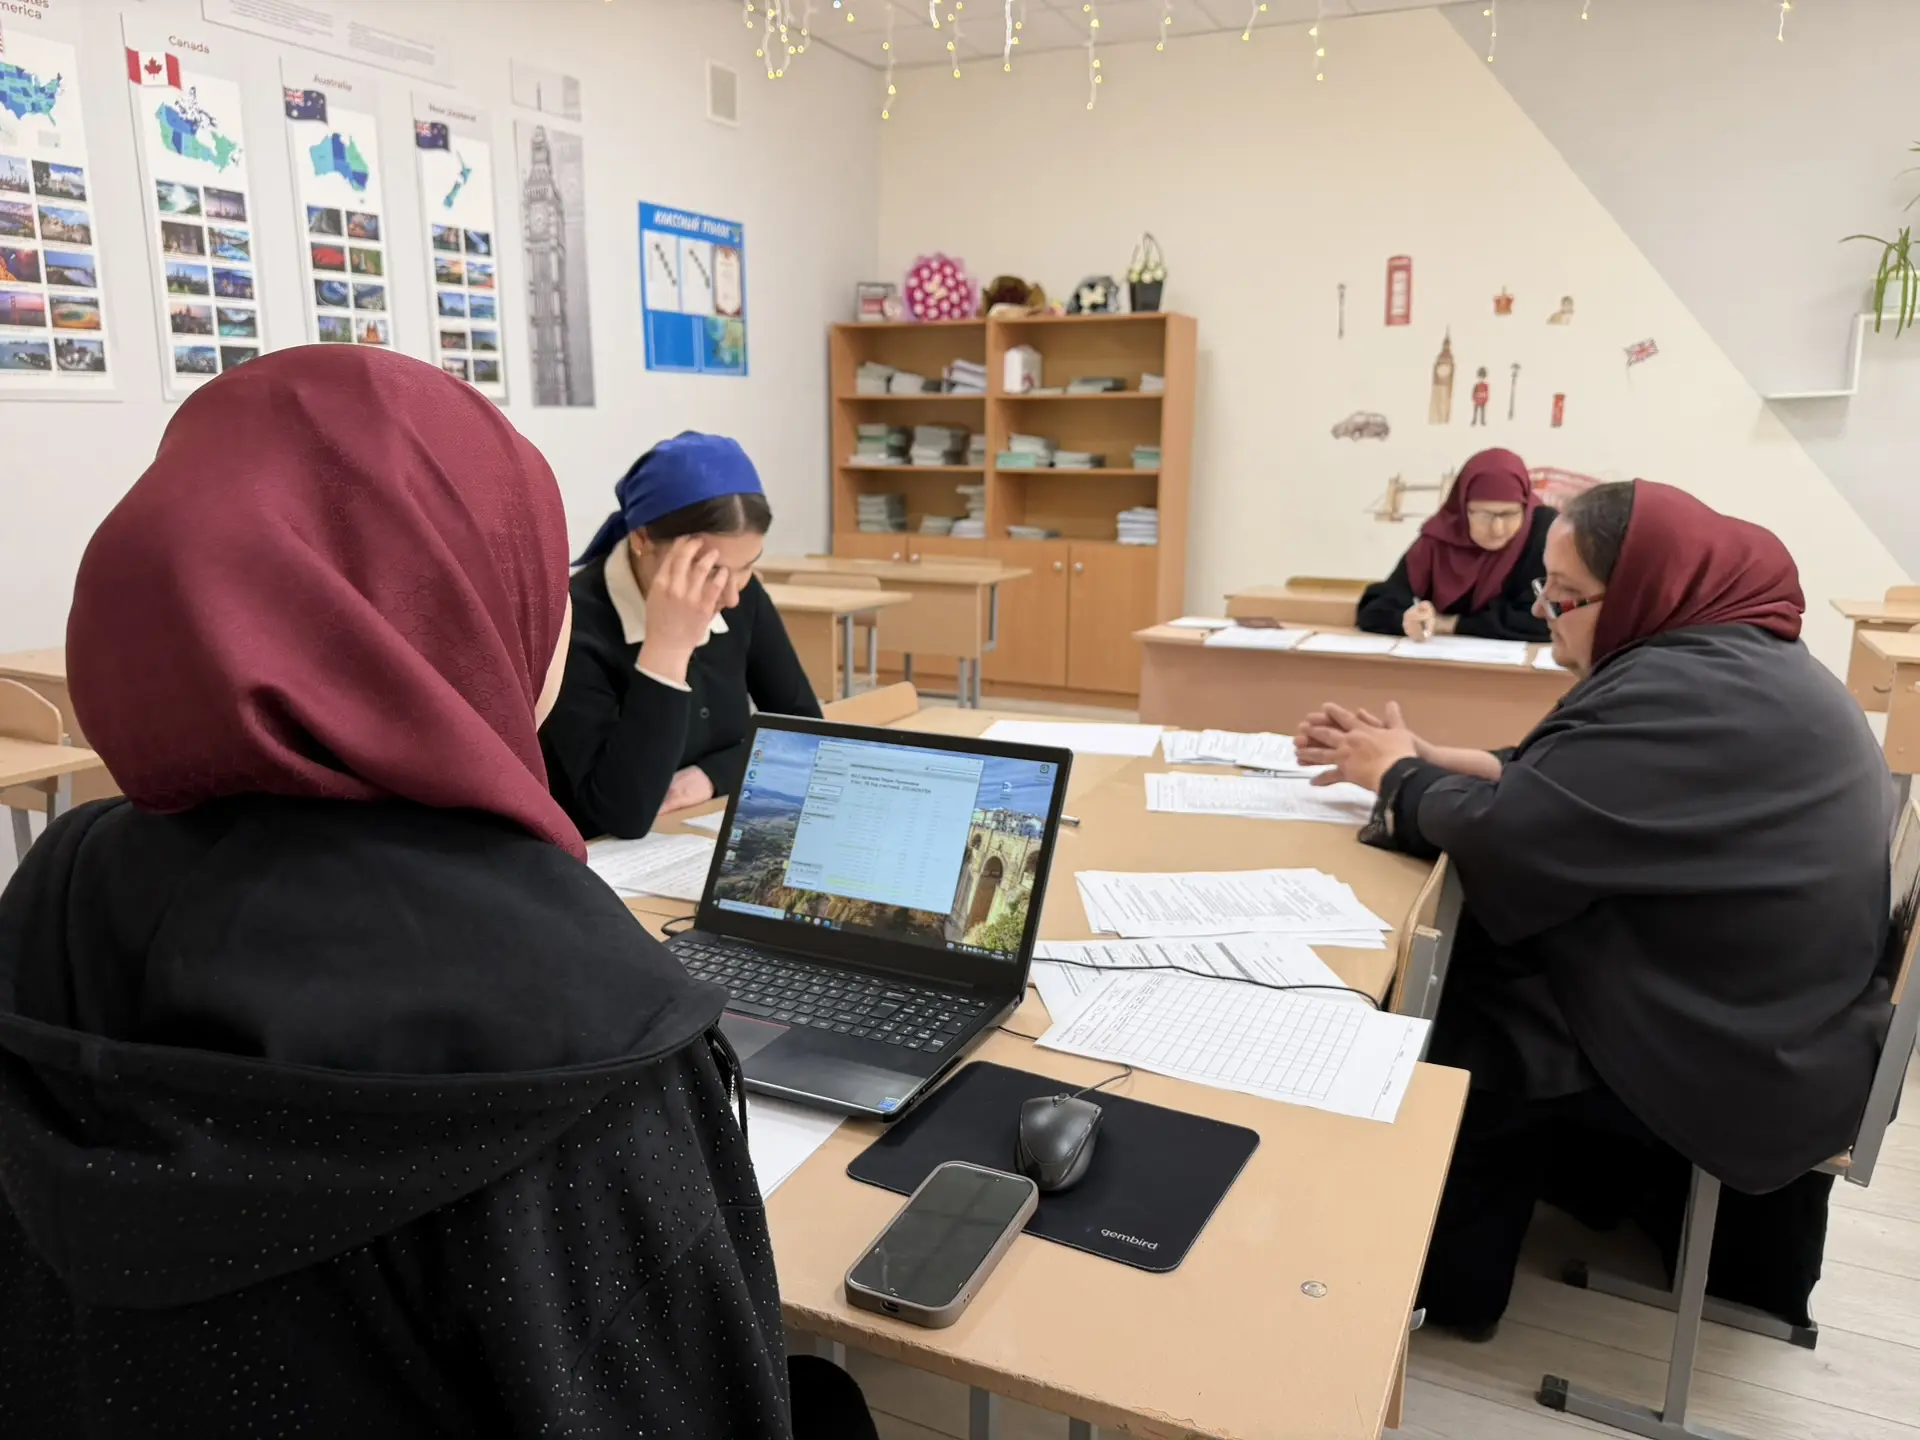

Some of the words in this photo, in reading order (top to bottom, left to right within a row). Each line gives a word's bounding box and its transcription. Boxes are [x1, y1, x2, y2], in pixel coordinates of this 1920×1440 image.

[169, 36, 209, 54] Canada
[313, 74, 352, 91] Australia
[1101, 1229, 1158, 1250] gembird
